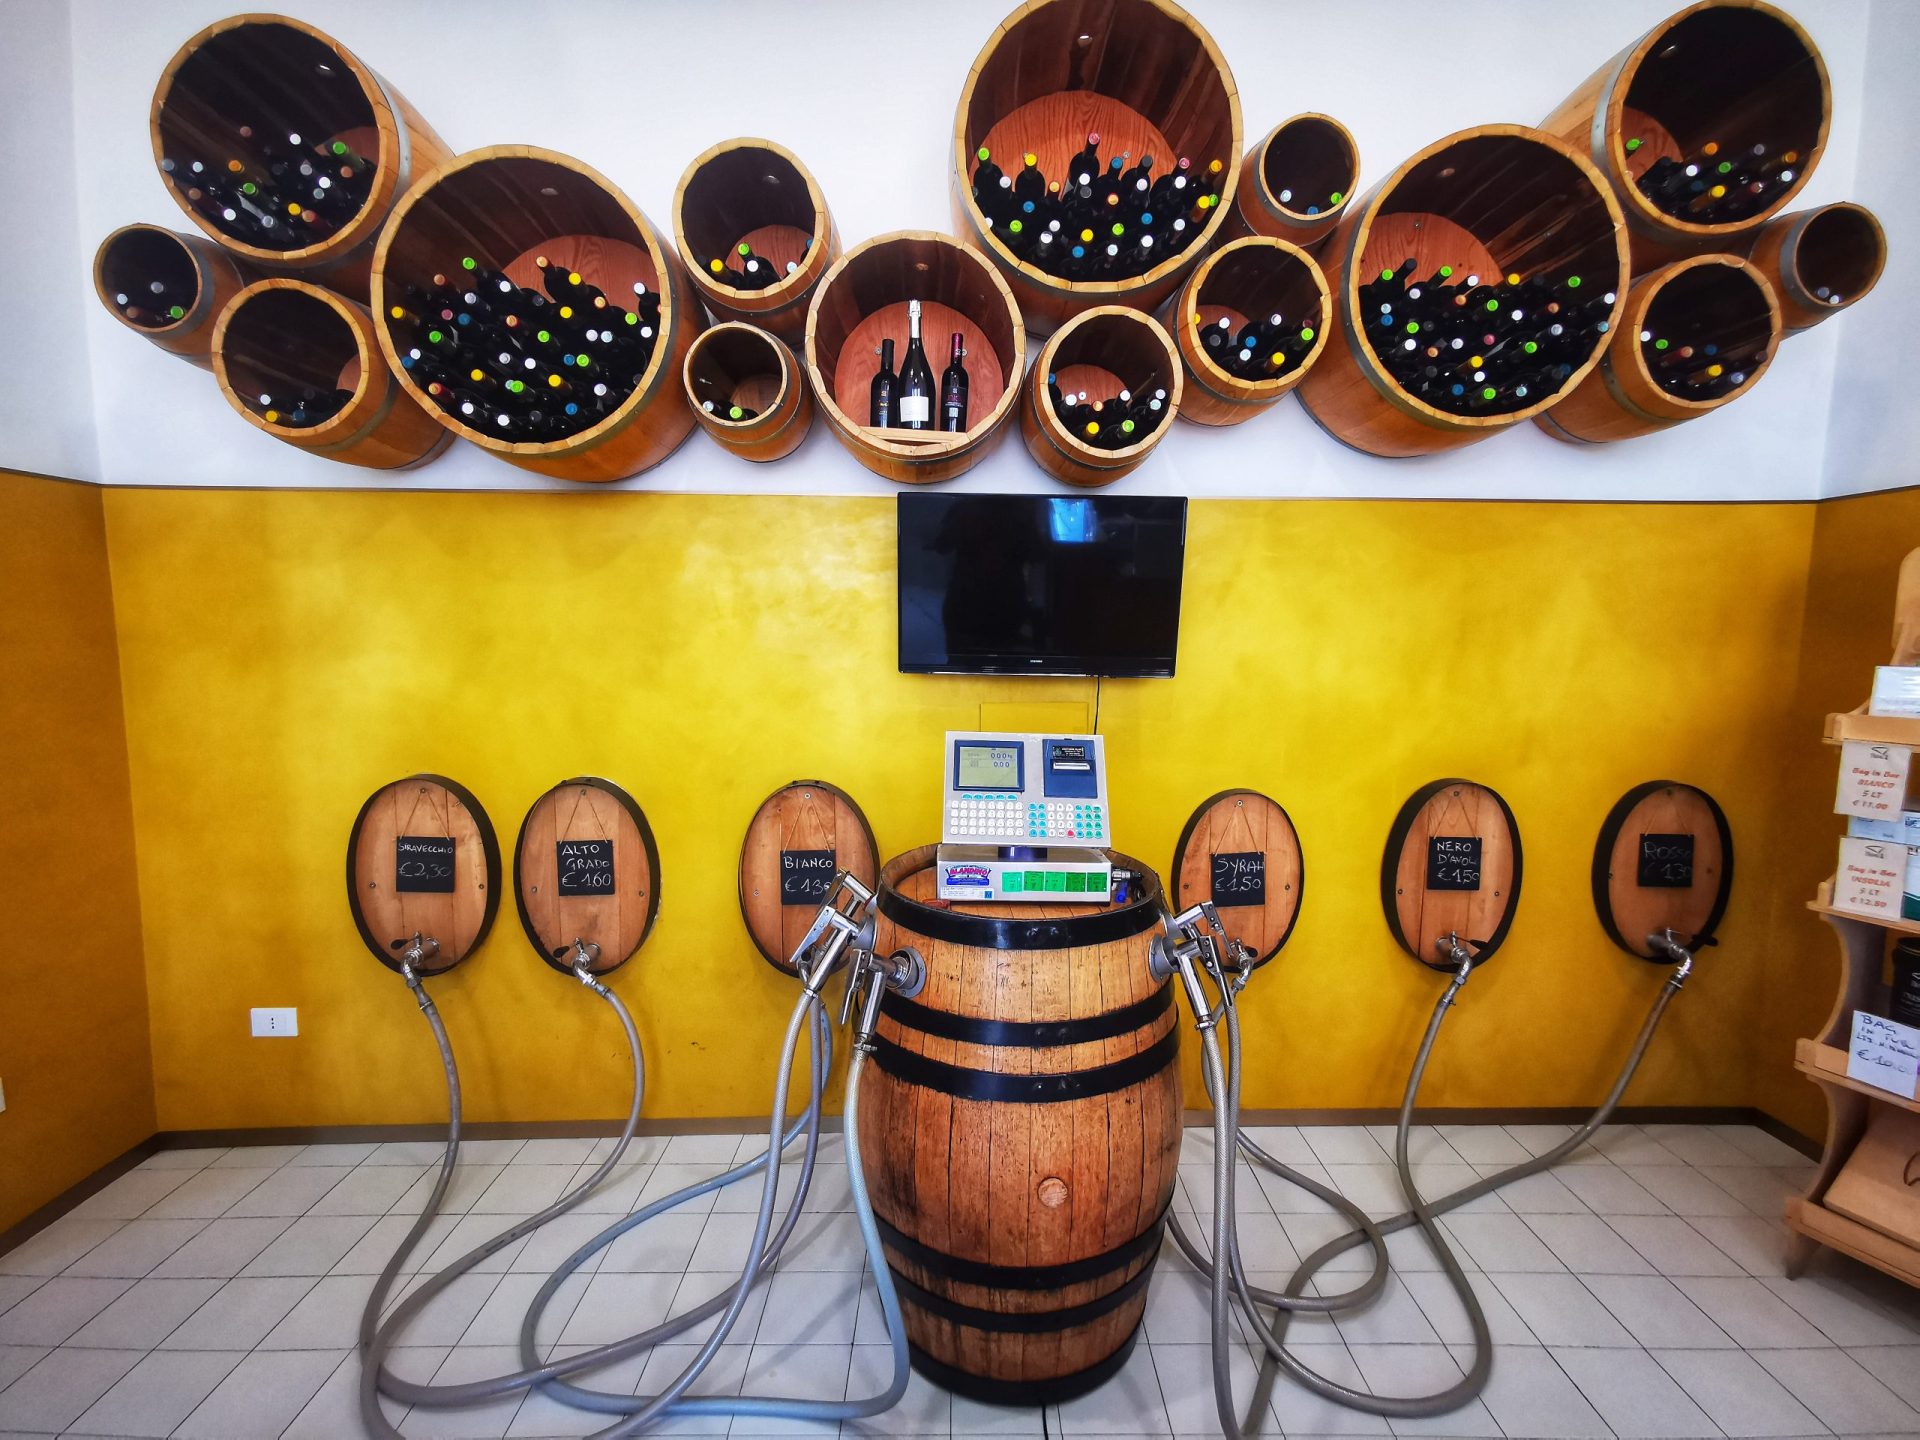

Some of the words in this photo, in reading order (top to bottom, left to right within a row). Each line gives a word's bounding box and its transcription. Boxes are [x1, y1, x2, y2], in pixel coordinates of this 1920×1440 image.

[561, 844, 600, 856] ALTO
[1436, 841, 1472, 852] NERO
[566, 857, 610, 871] GRADO
[783, 855, 833, 869] BIANCO
[1214, 858, 1264, 877] SYRAH
